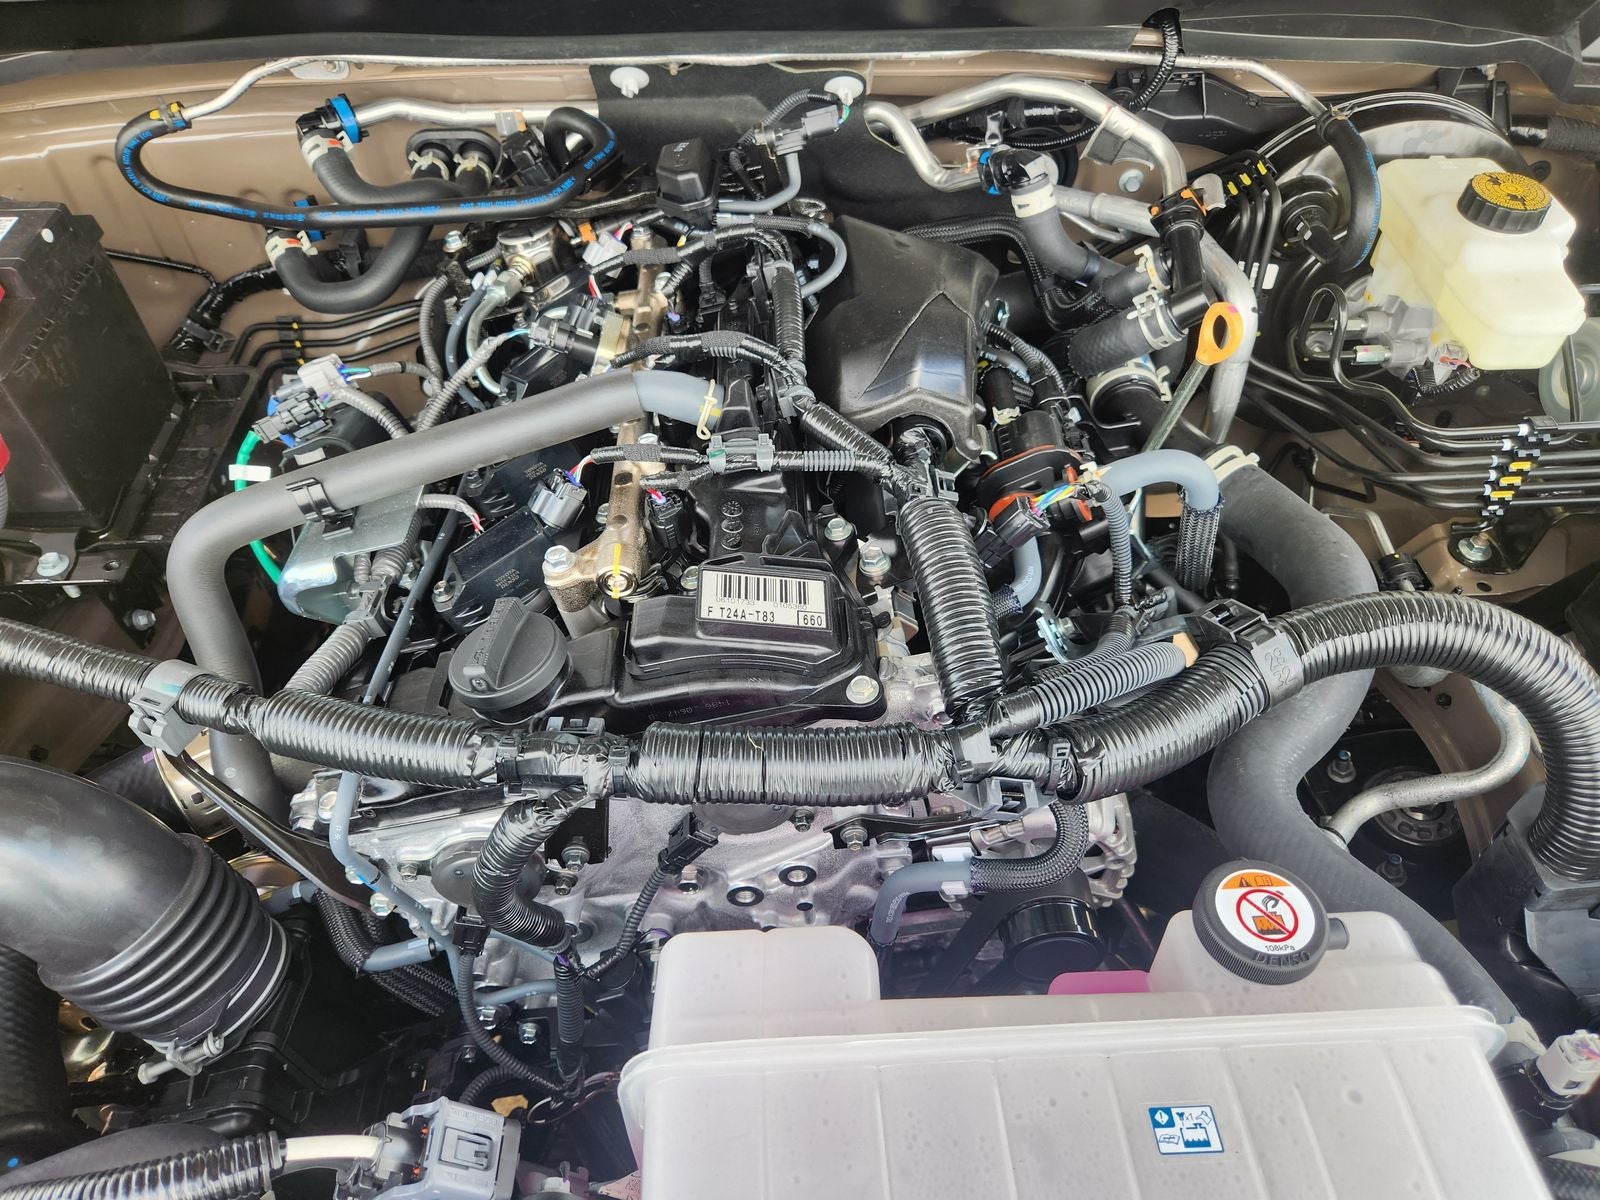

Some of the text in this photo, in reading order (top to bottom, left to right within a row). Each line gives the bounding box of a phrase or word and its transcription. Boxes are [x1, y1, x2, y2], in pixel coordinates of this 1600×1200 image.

[707, 606, 823, 627] F T24A-T83 660
[1264, 944, 1296, 952] 108kPa
[1254, 951, 1311, 967] DENSO
